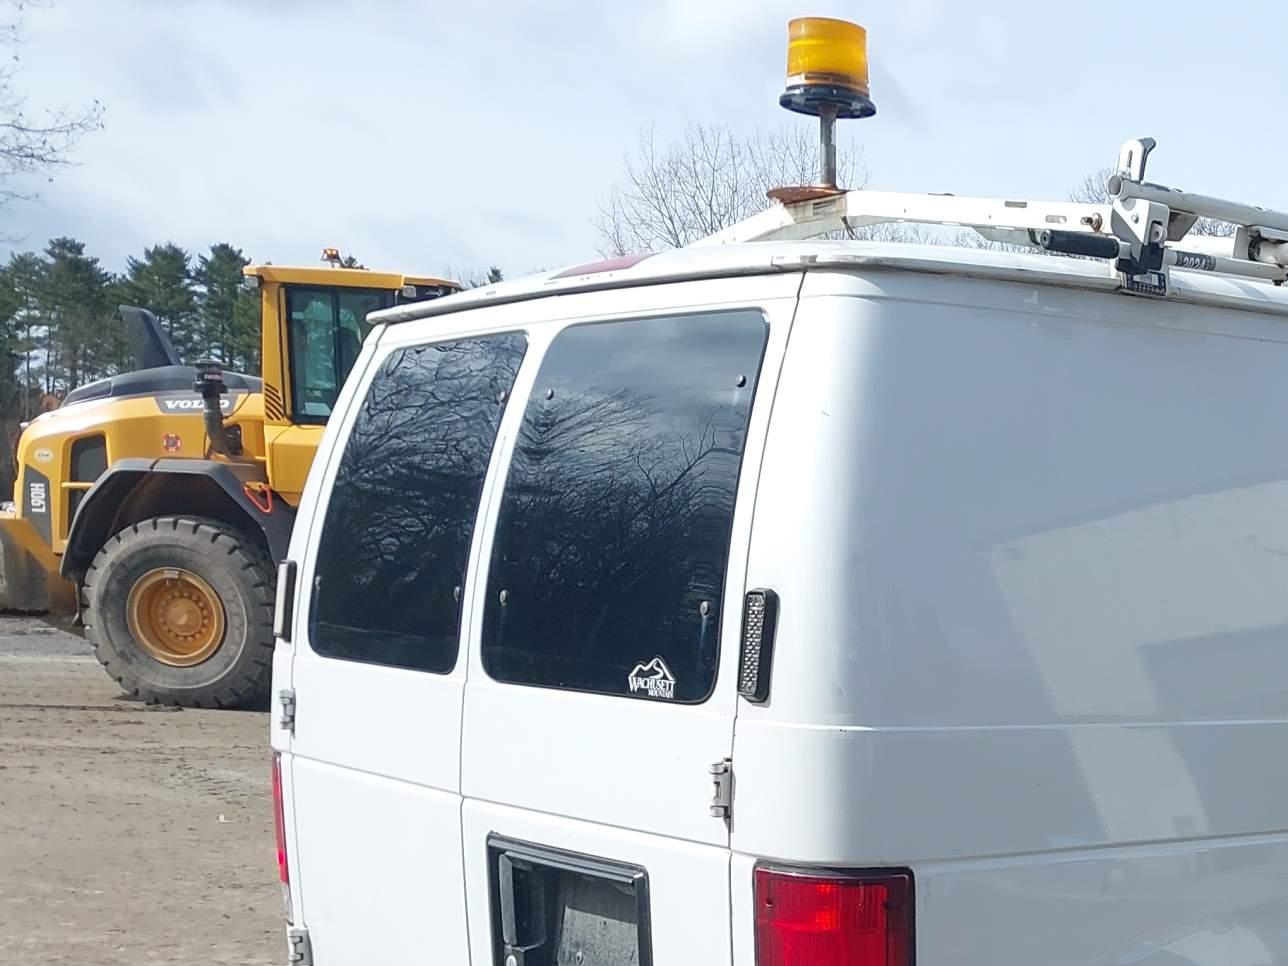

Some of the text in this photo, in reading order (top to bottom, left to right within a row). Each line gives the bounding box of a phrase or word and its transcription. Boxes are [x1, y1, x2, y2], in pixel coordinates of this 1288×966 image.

[164, 400, 230, 409] VOLO
[30, 483, 46, 513] L90H
[628, 676, 676, 694] WACHUSETT
[648, 688, 674, 699] MOUNTAIN
